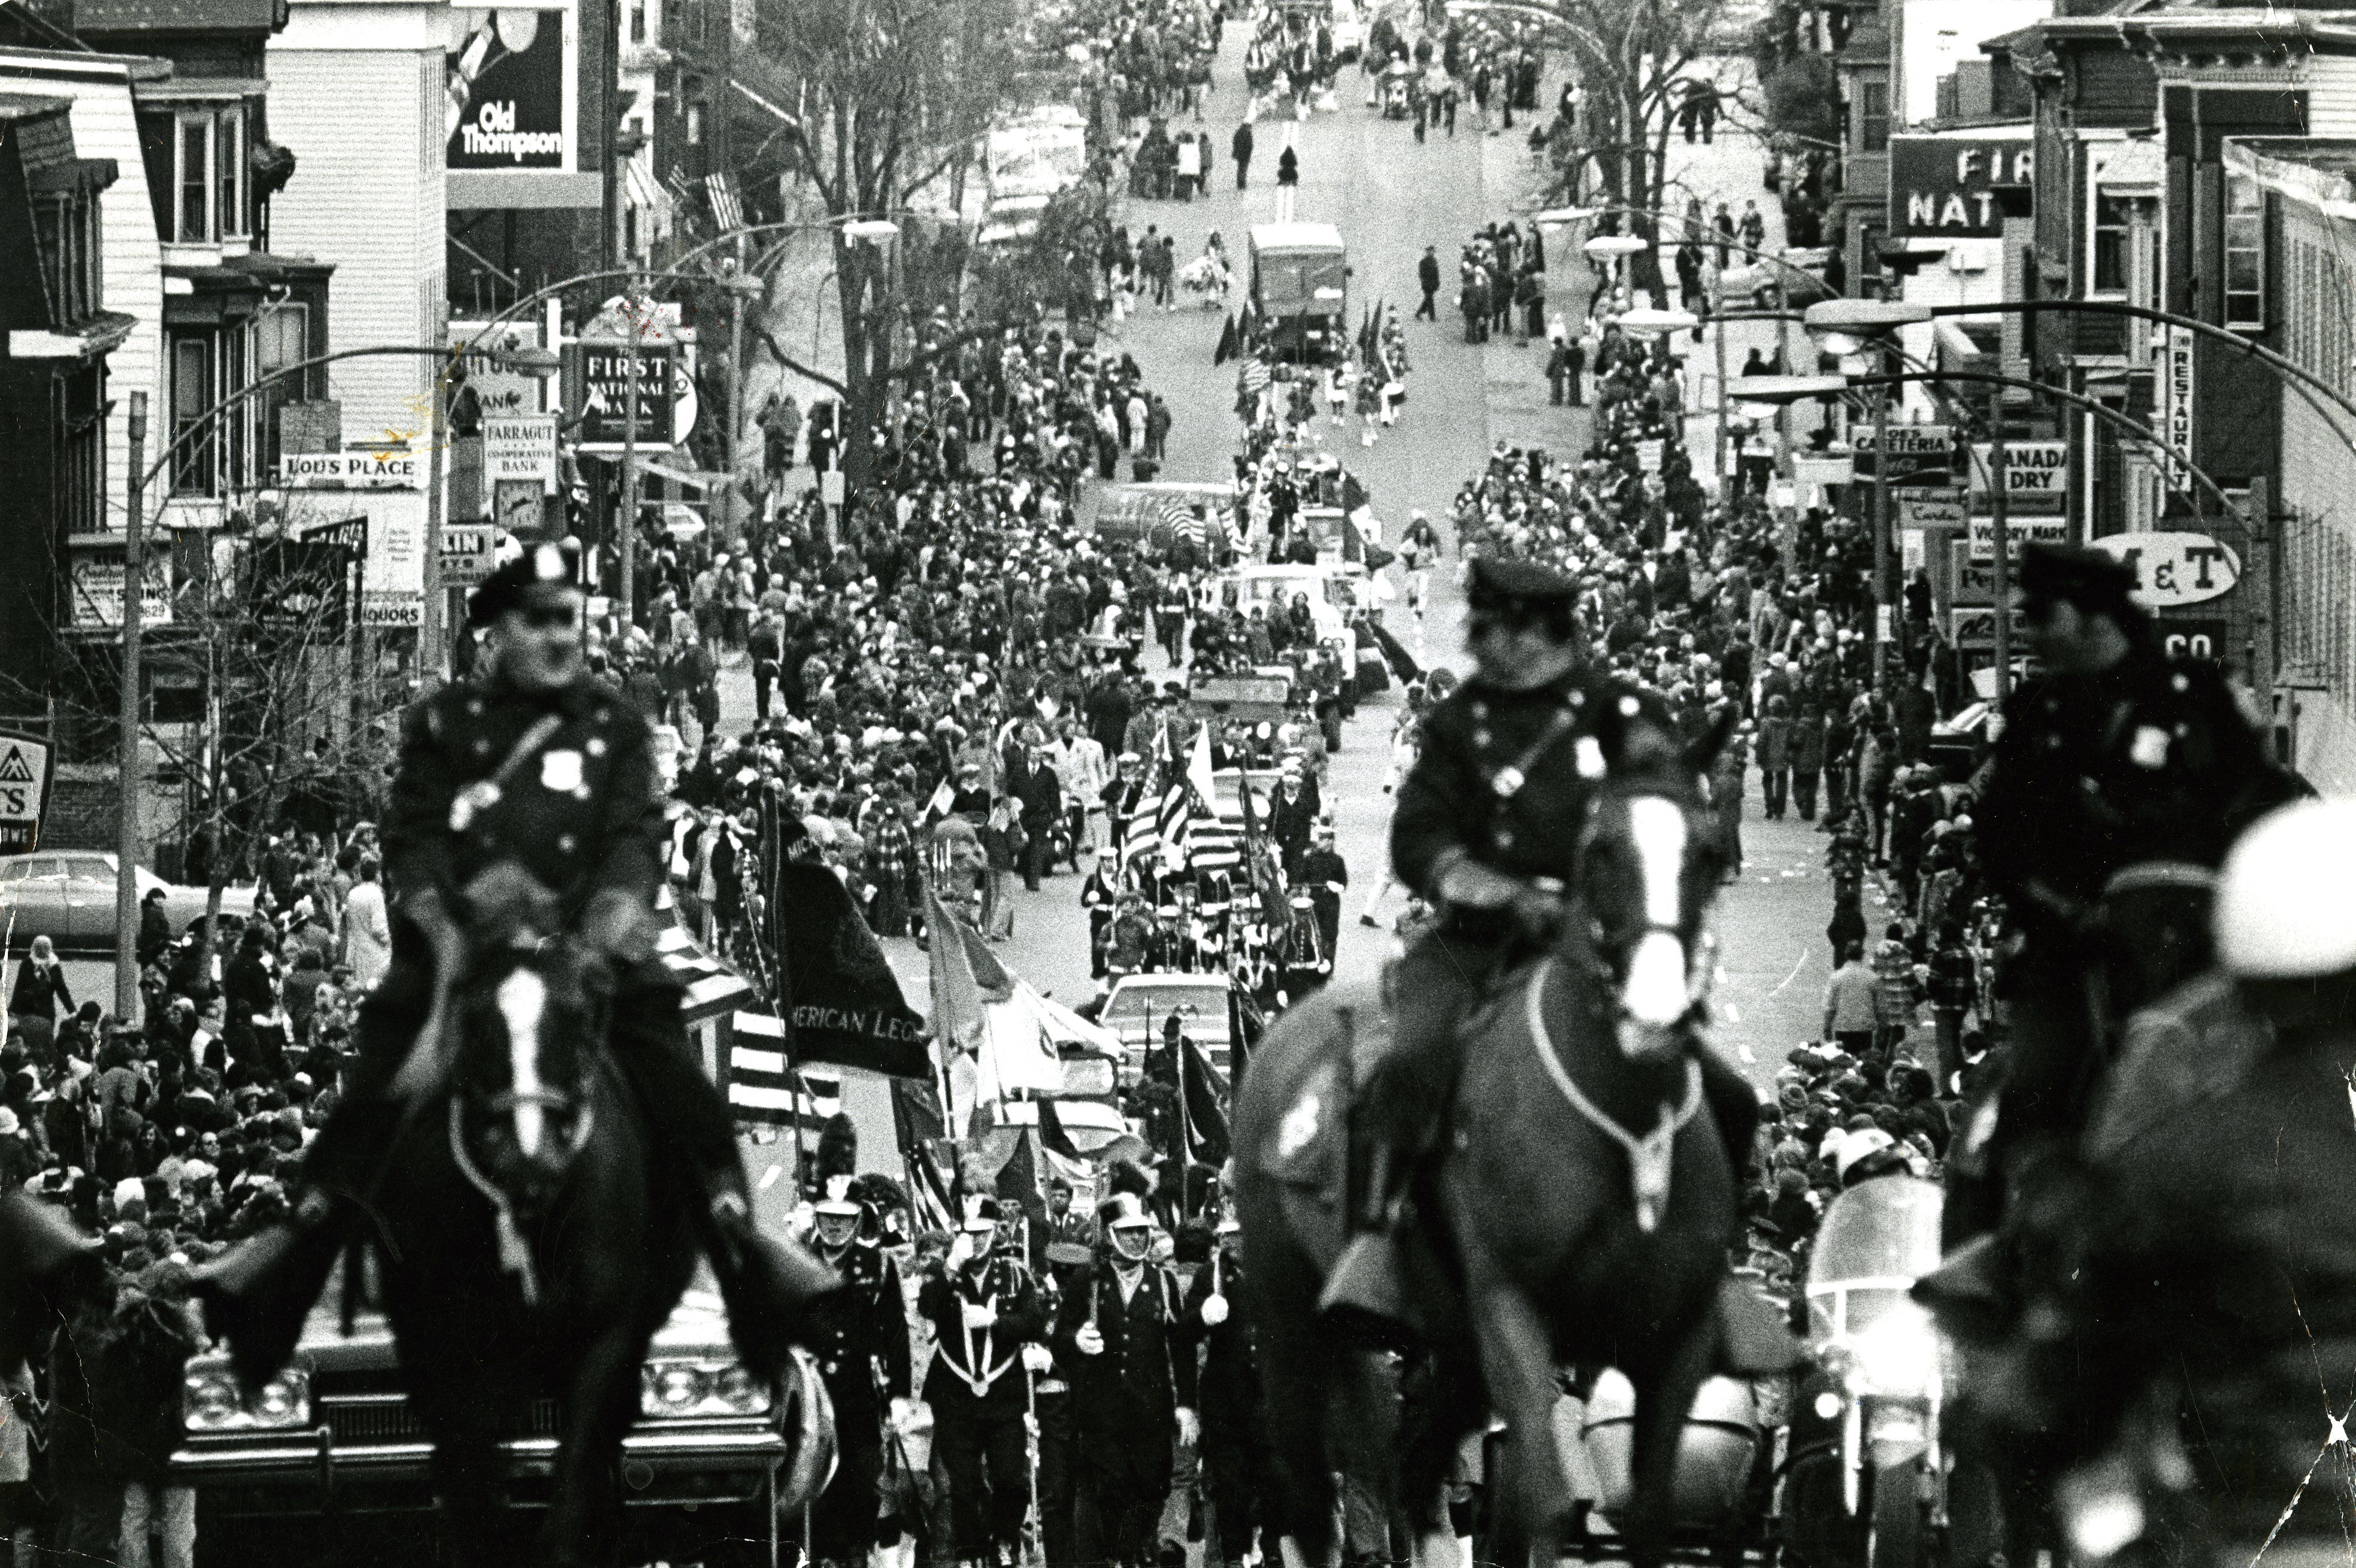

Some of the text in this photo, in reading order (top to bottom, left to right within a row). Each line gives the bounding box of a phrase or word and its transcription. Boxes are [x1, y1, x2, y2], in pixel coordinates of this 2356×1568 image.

[480, 100, 516, 132] Old
[461, 122, 563, 162] Thompson
[1907, 190, 1994, 228] NAT
[588, 357, 668, 378] FIRST
[2174, 351, 2188, 487] RESTAURAT
[488, 424, 553, 441] FARRAGUT
[1856, 436, 1944, 450] CAETERIA
[349, 459, 414, 475] PLACE
[502, 460, 538, 472] BANK
[2010, 471, 2054, 489] DRY
[1975, 526, 2028, 539] VICORY
